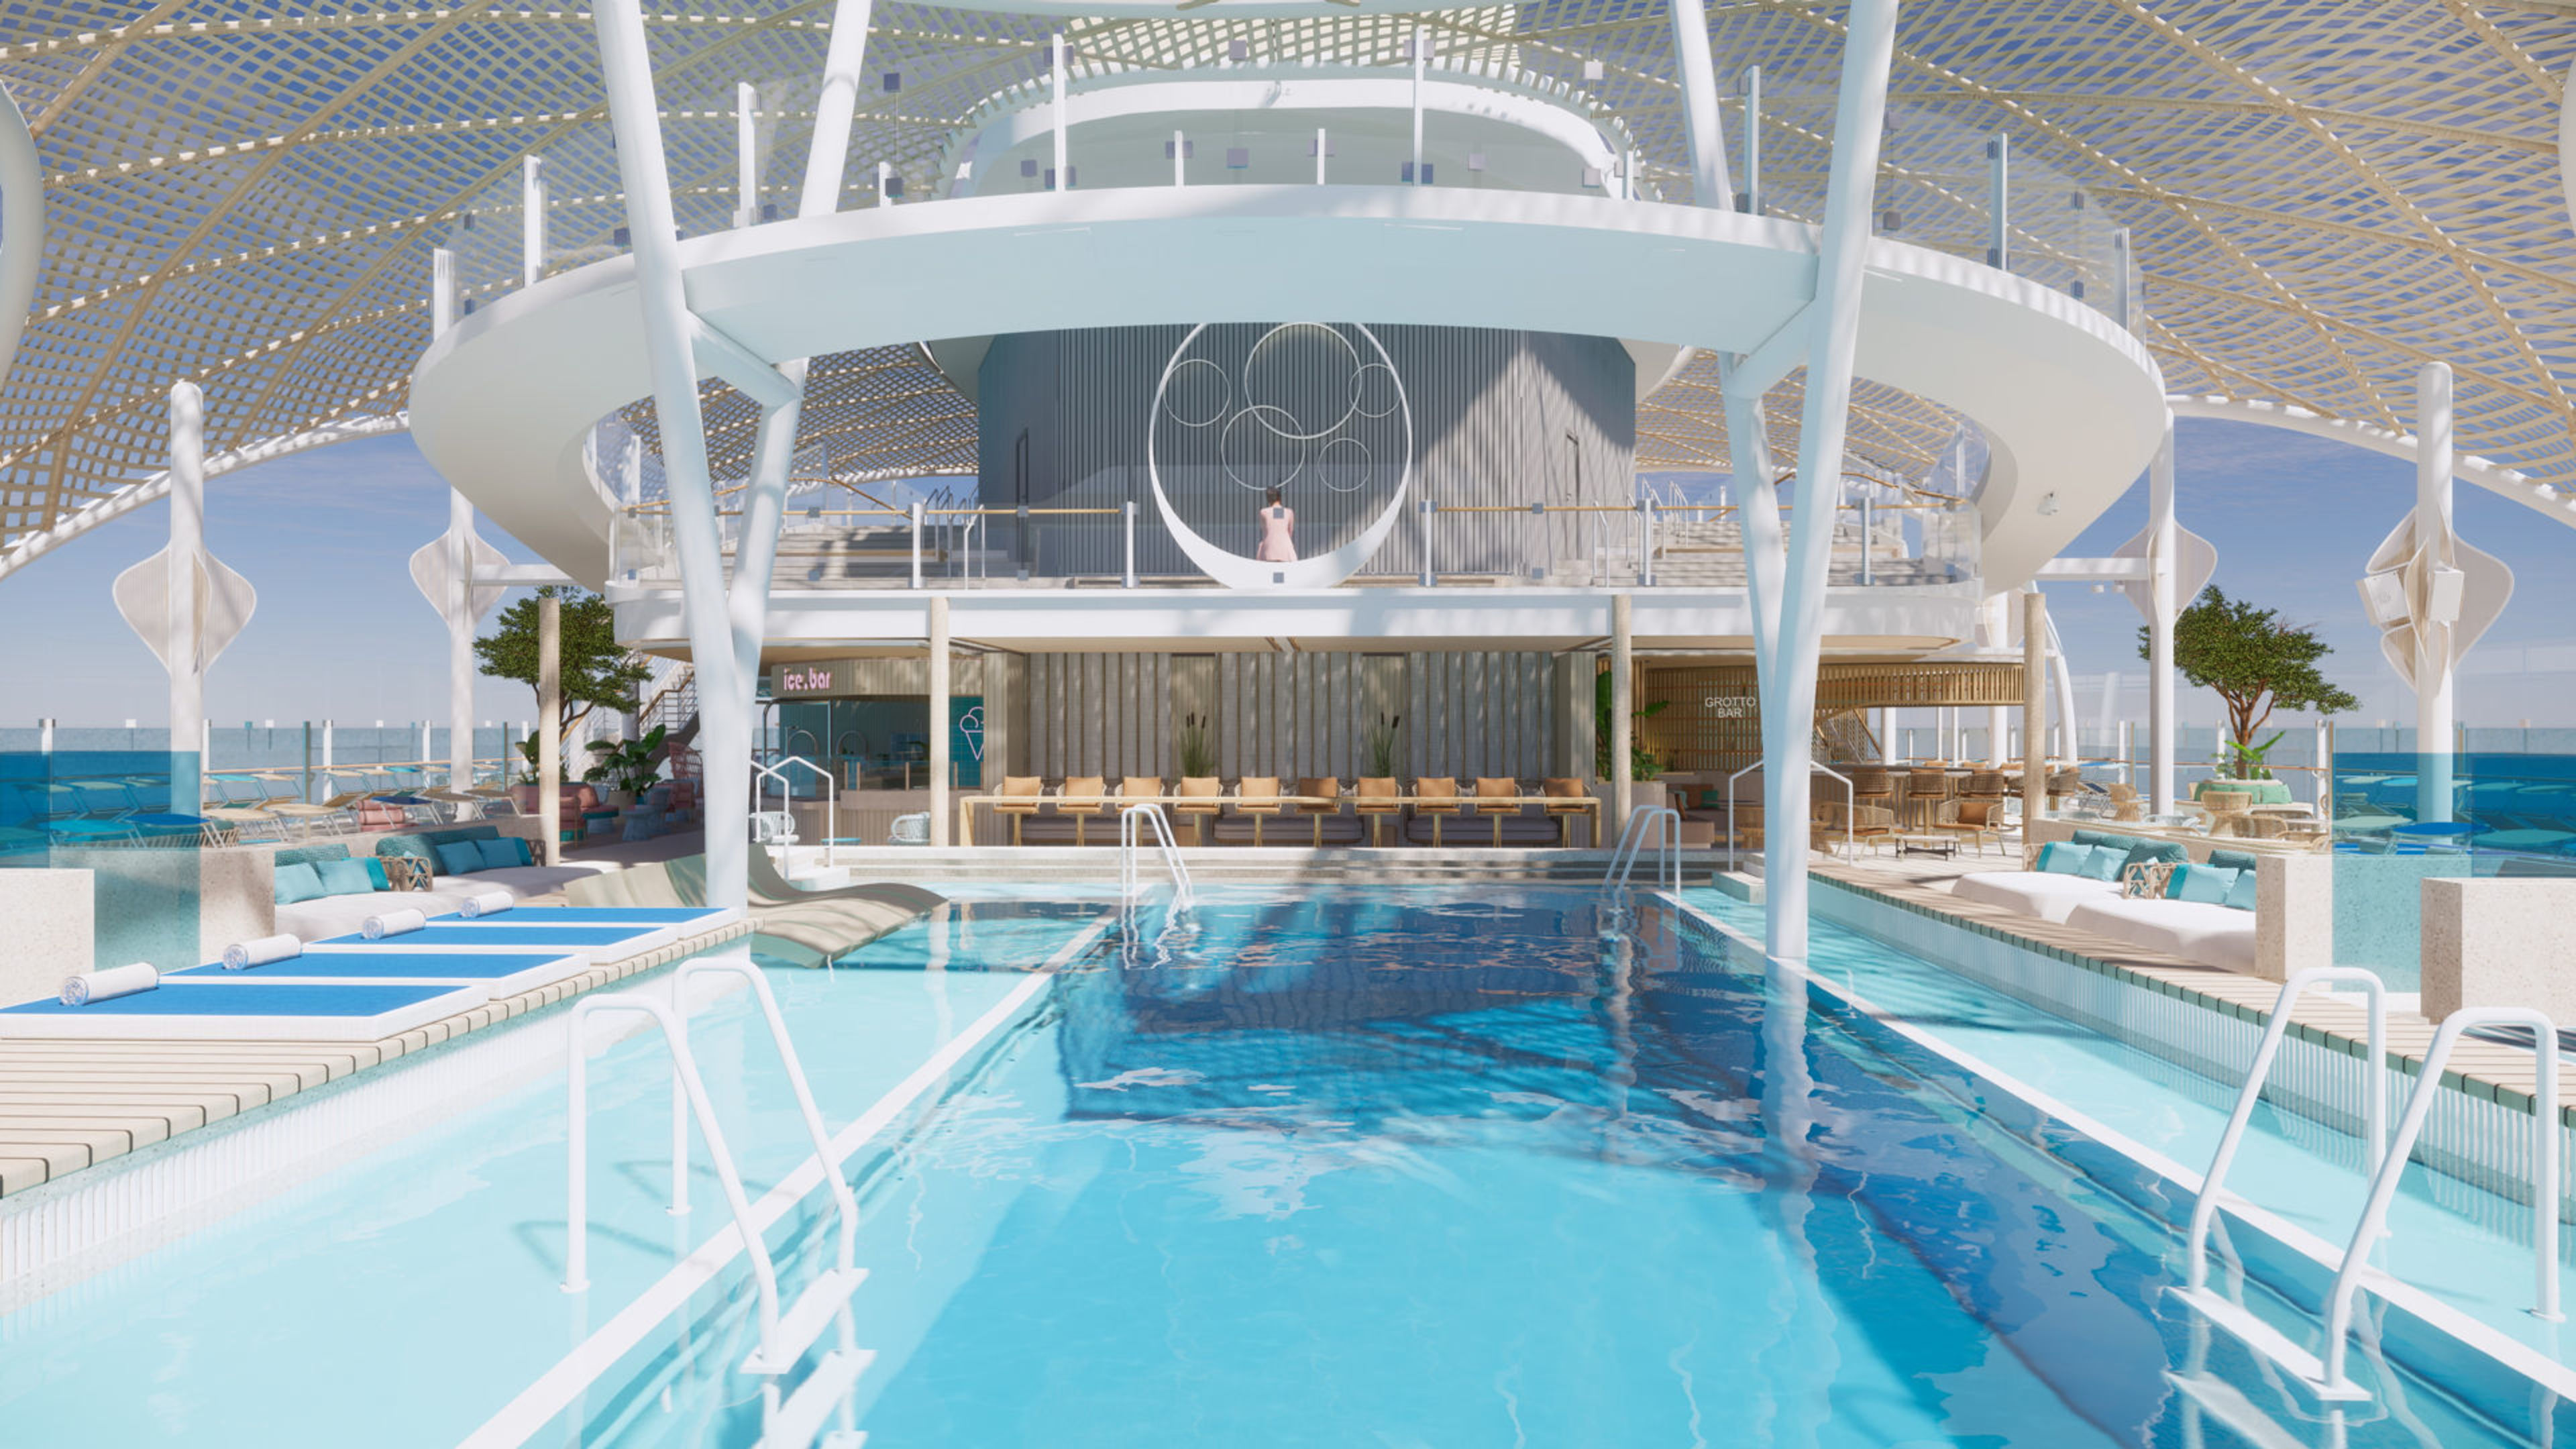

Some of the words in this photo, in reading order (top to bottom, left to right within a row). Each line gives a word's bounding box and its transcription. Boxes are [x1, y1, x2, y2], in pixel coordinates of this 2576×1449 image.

[784, 667, 830, 690] ice.bar
[1705, 697, 1756, 708] GROTTO
[1718, 708, 1743, 718] BAR
